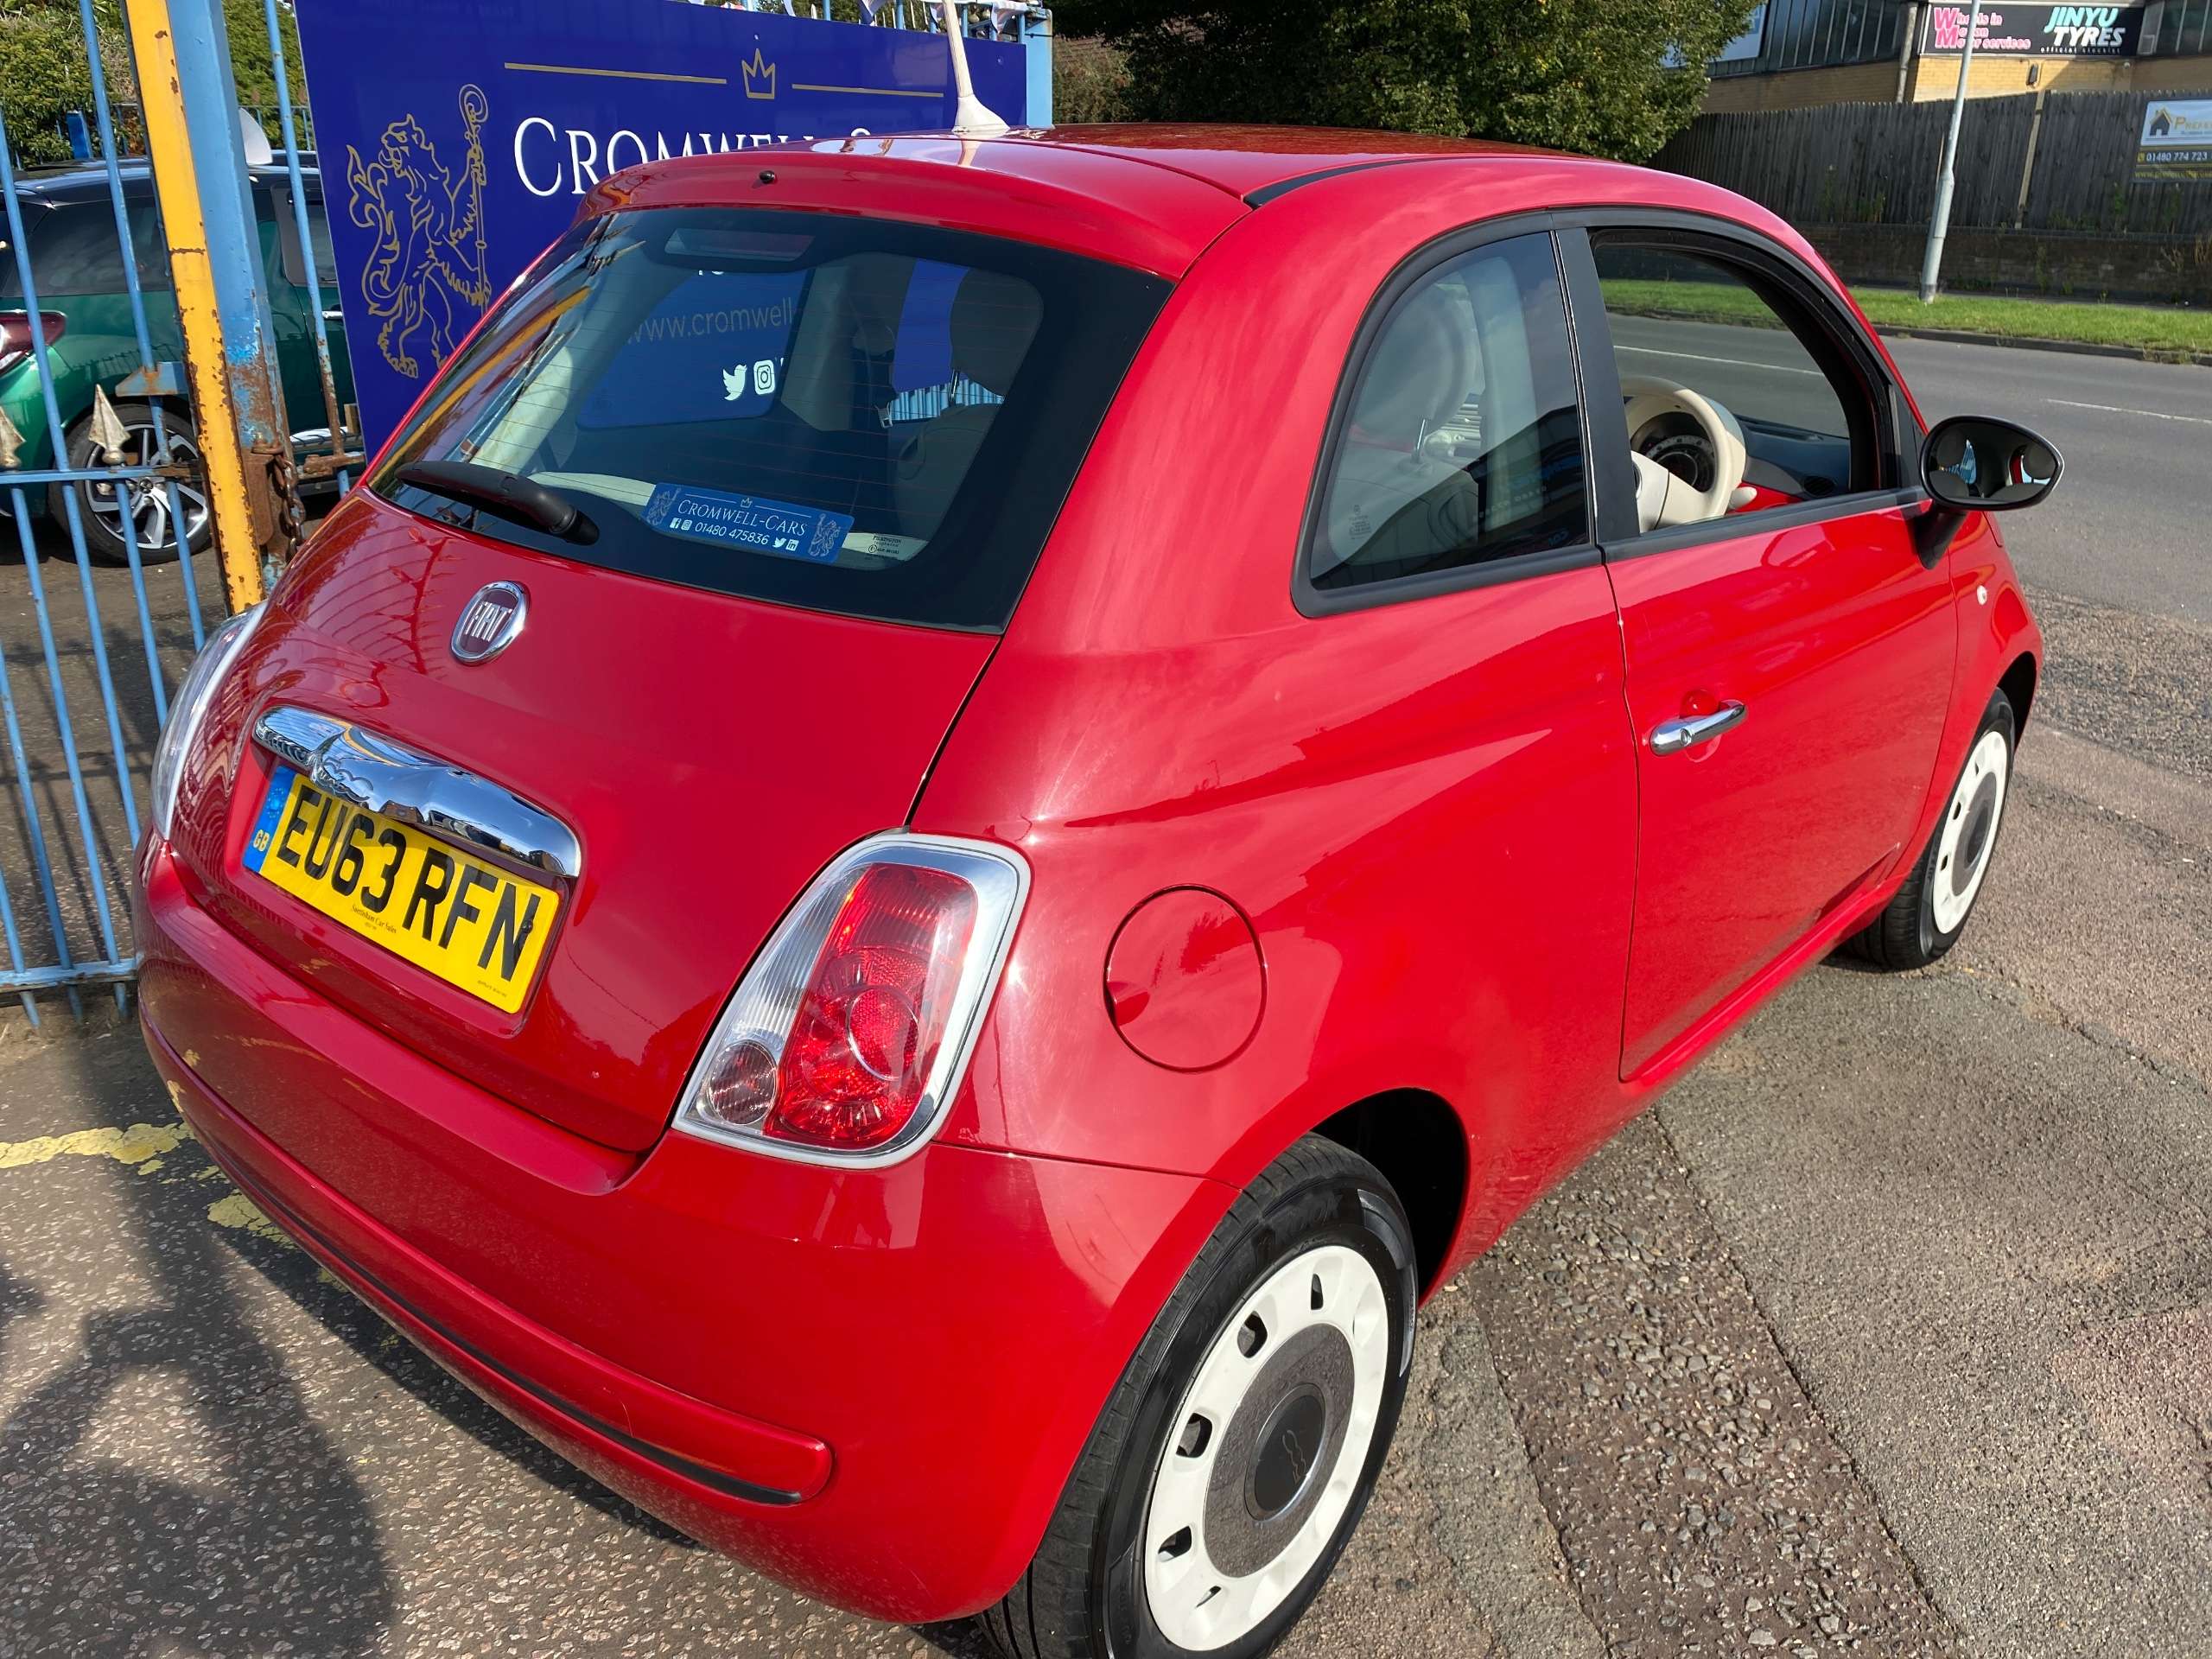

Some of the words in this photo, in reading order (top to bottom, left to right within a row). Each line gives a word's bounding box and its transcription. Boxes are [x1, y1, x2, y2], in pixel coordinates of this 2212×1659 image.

[2044, 6, 2119, 33] JINYU
[2053, 26, 2126, 47] TYRES
[677, 499, 808, 537] CROMWELL-CARS
[695, 522, 728, 537] 01480
[728, 529, 771, 545] 475836
[465, 601, 513, 642] FIAT
[253, 829, 270, 852] GB
[276, 784, 407, 913] EU63
[402, 846, 542, 982] RFN
